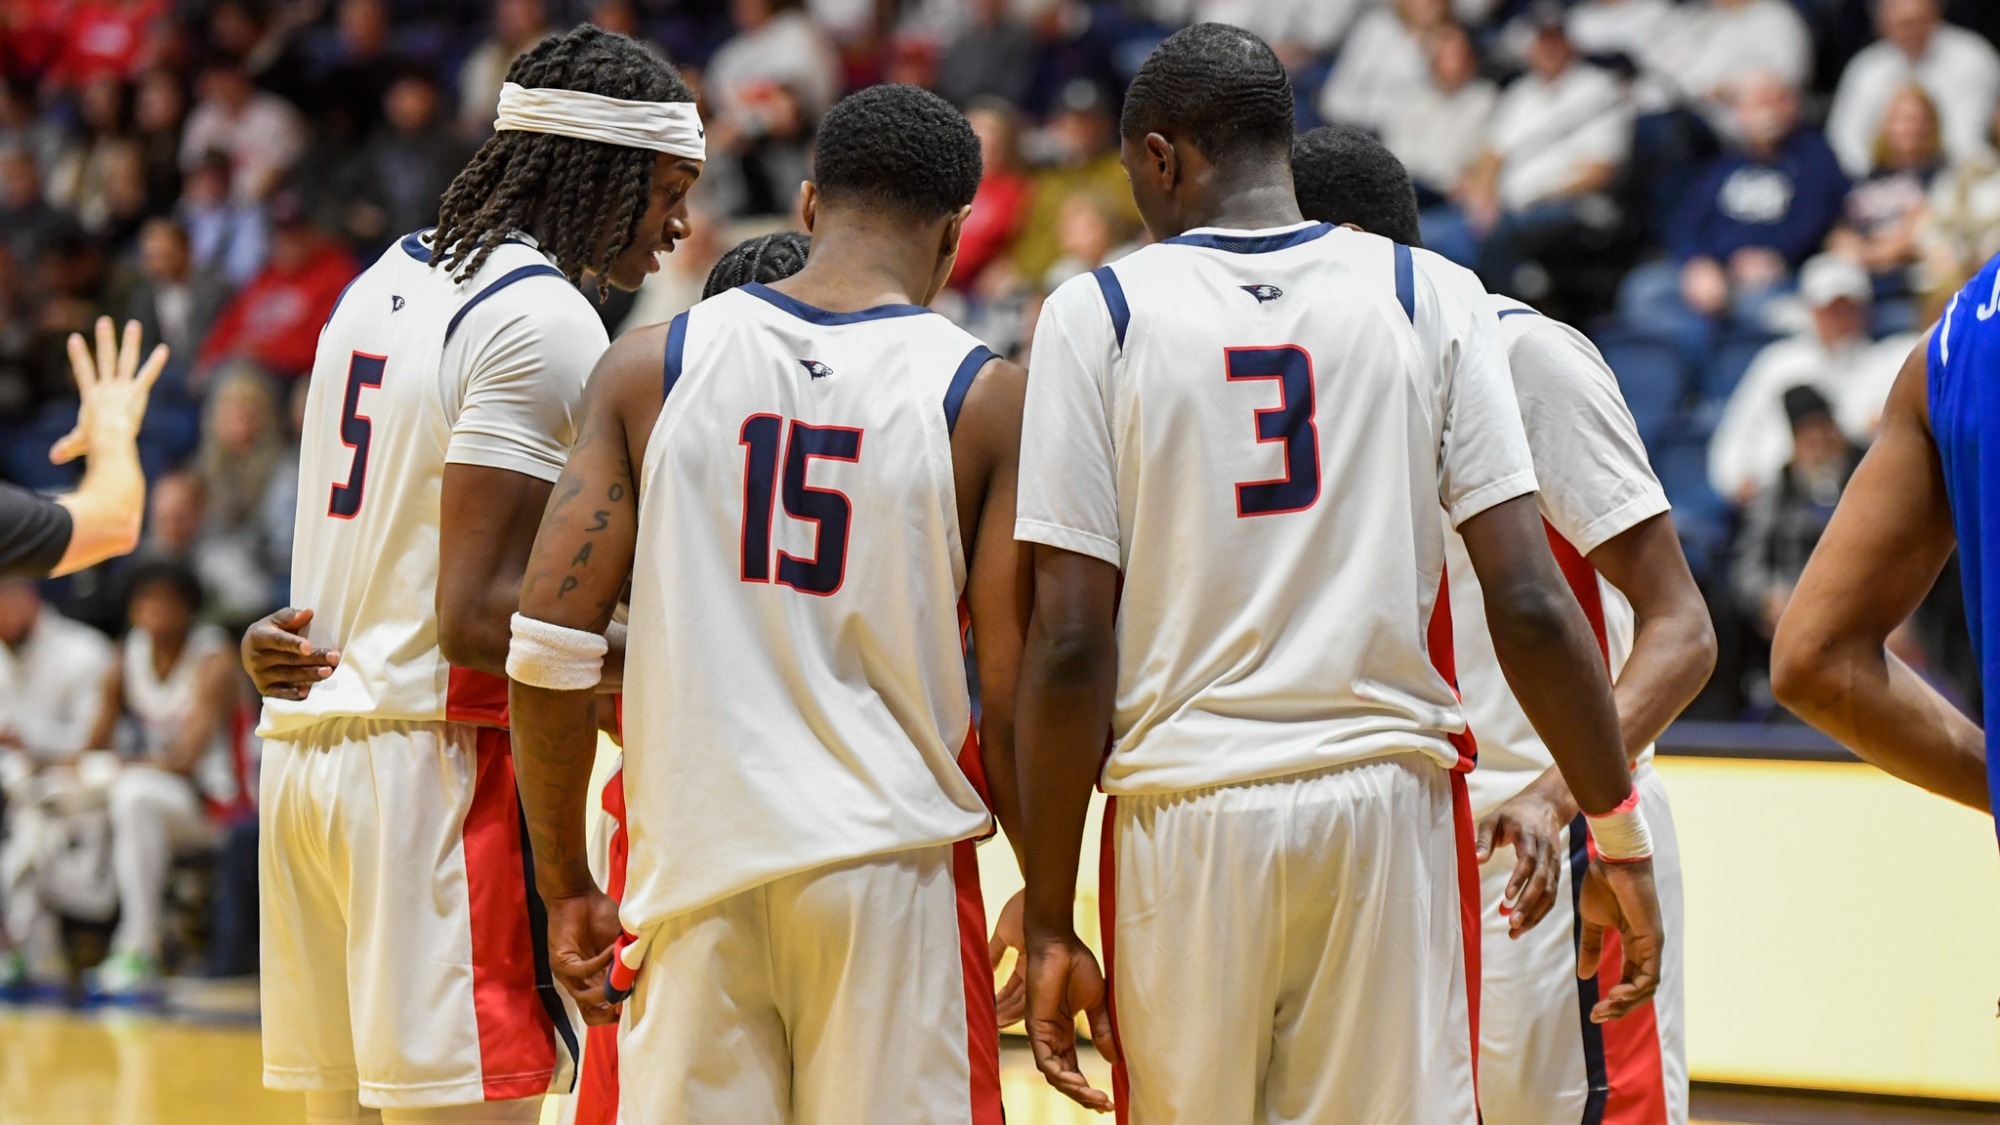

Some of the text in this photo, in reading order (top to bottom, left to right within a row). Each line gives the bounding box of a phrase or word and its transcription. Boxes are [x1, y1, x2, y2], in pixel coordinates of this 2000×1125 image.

[329, 350, 388, 519] 5
[740, 413, 863, 596] 15
[1224, 344, 1321, 518] 3
